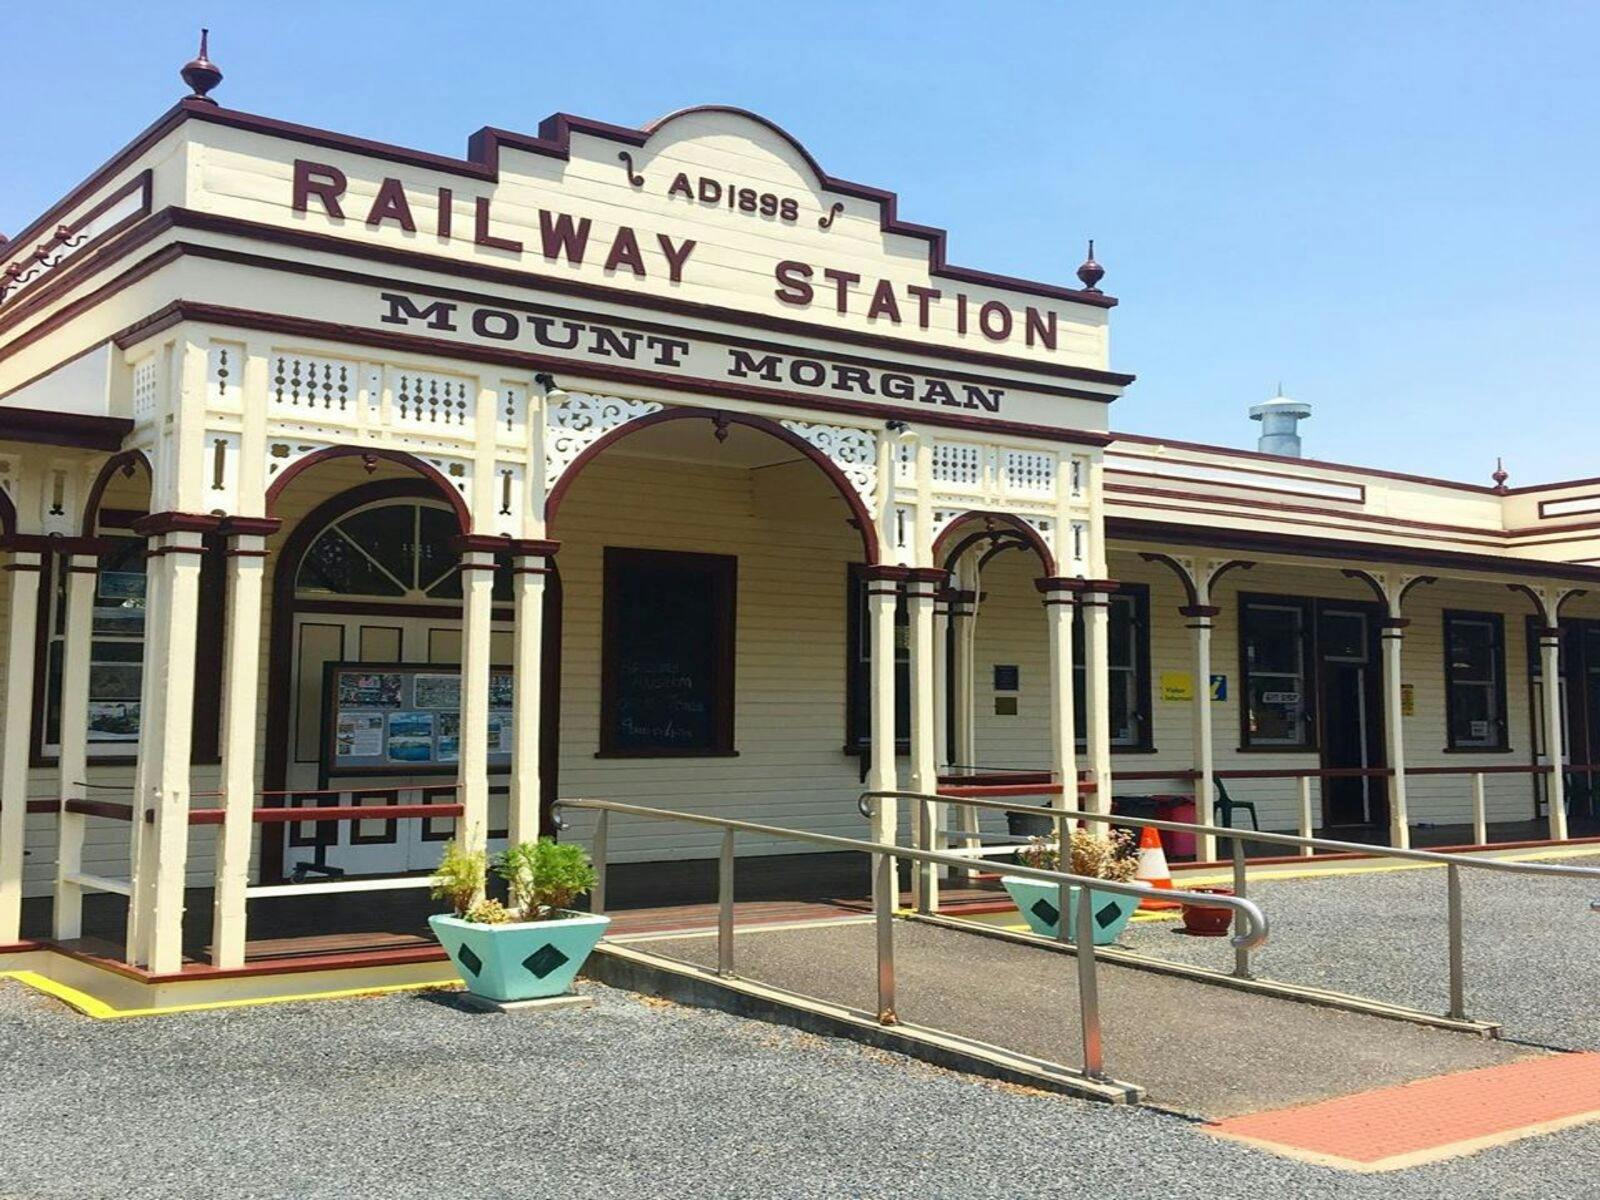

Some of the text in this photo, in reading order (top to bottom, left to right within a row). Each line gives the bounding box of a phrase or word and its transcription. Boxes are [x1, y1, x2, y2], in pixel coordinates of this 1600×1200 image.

[291, 158, 1057, 350] RAILWAY STATION
[380, 292, 1005, 413] MOUNT MORGAN
